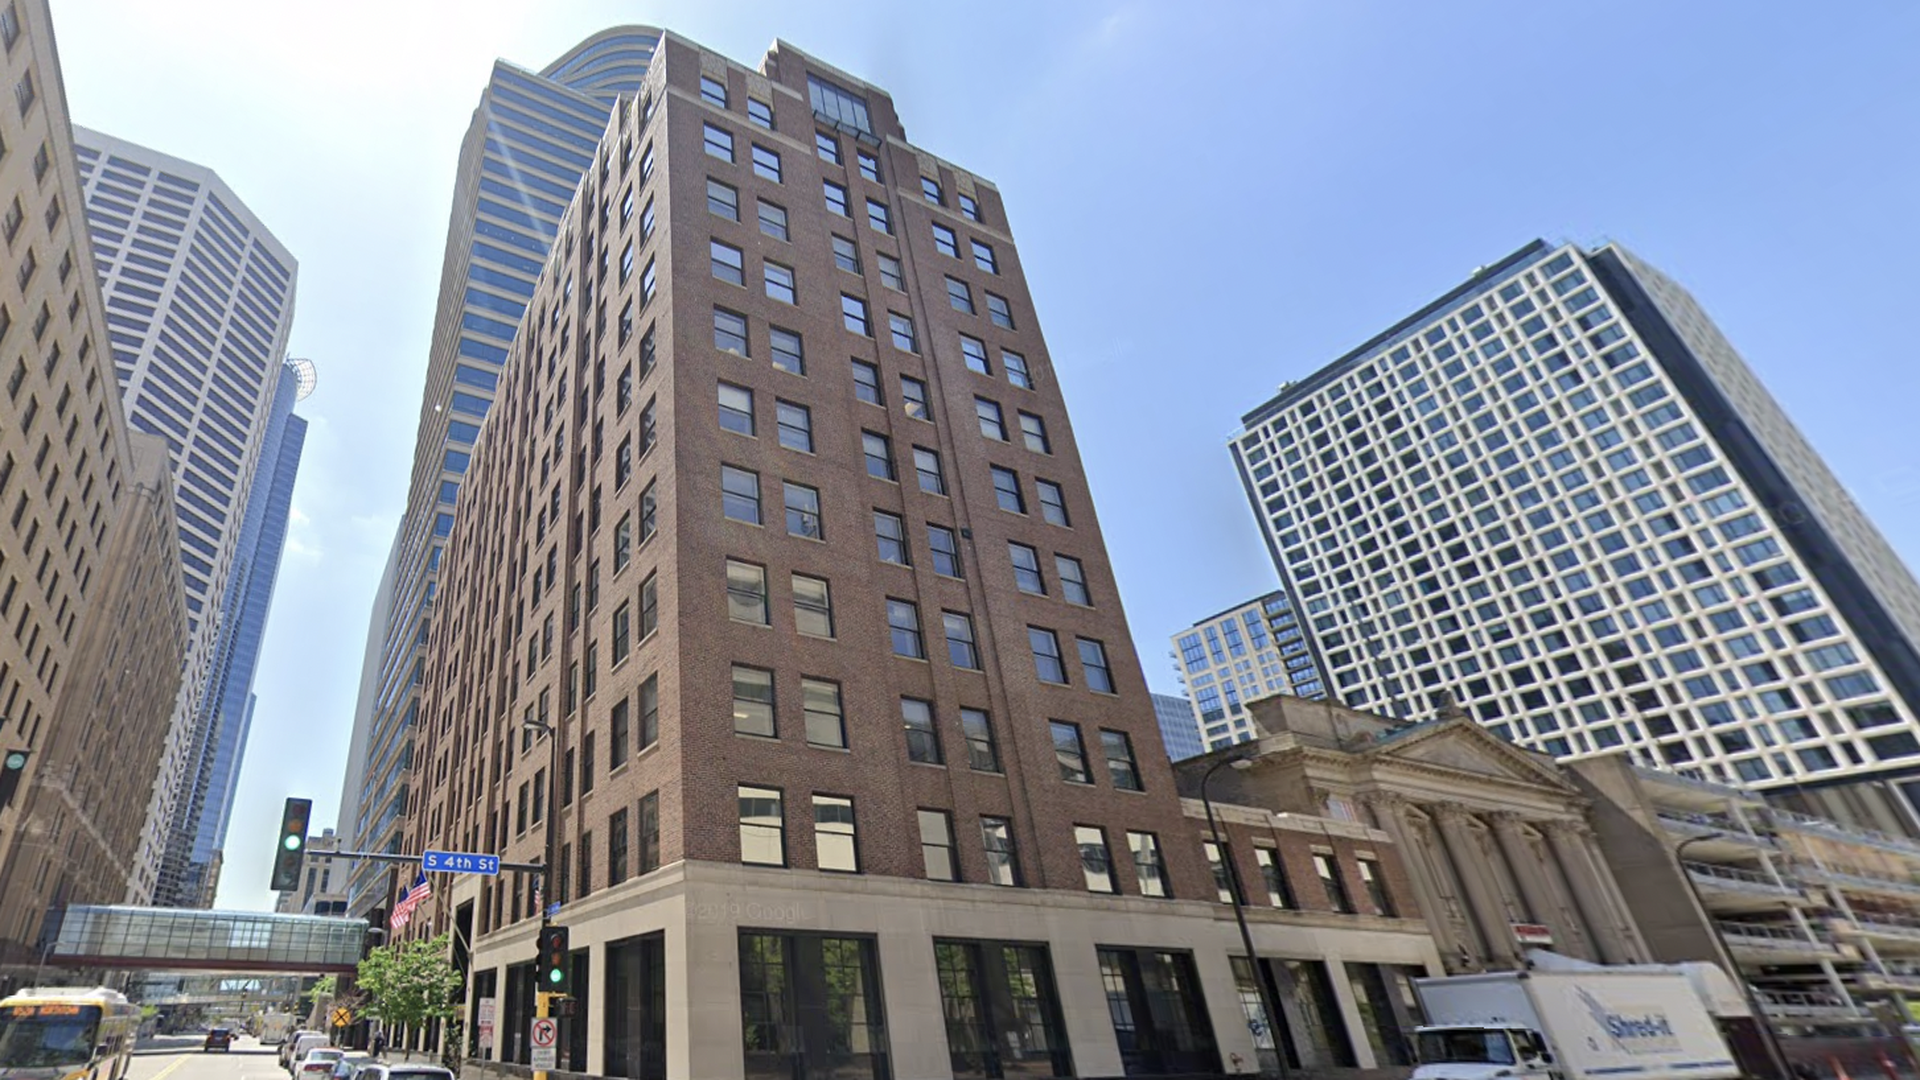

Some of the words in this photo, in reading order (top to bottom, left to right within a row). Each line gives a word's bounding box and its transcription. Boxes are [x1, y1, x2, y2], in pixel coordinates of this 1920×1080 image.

[428, 855, 437, 867] S
[444, 856, 472, 869] 4th
[479, 858, 494, 871] St
